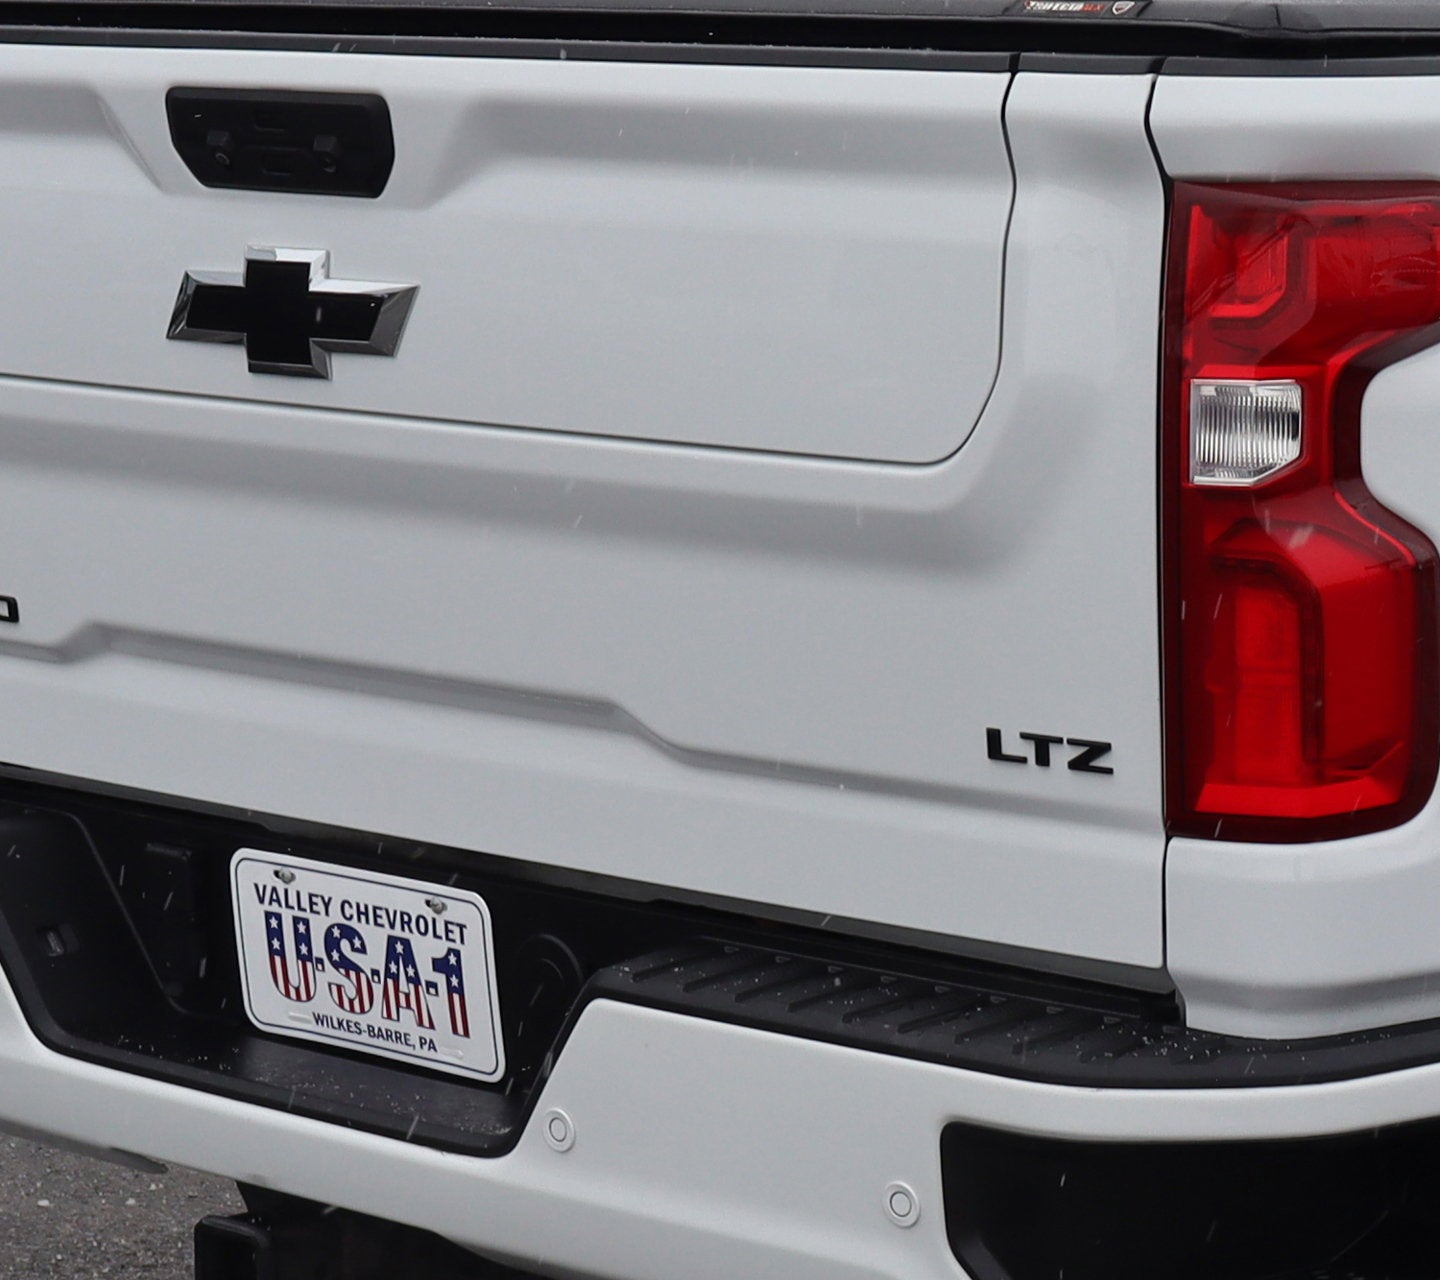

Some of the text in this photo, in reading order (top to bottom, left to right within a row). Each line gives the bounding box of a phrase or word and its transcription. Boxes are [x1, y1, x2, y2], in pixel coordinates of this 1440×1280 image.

[986, 727, 1114, 775] LTZ
[254, 882, 468, 946] VALLEY CHEVROLET
[311, 1011, 438, 1054] WILKES-BARRE, PA
